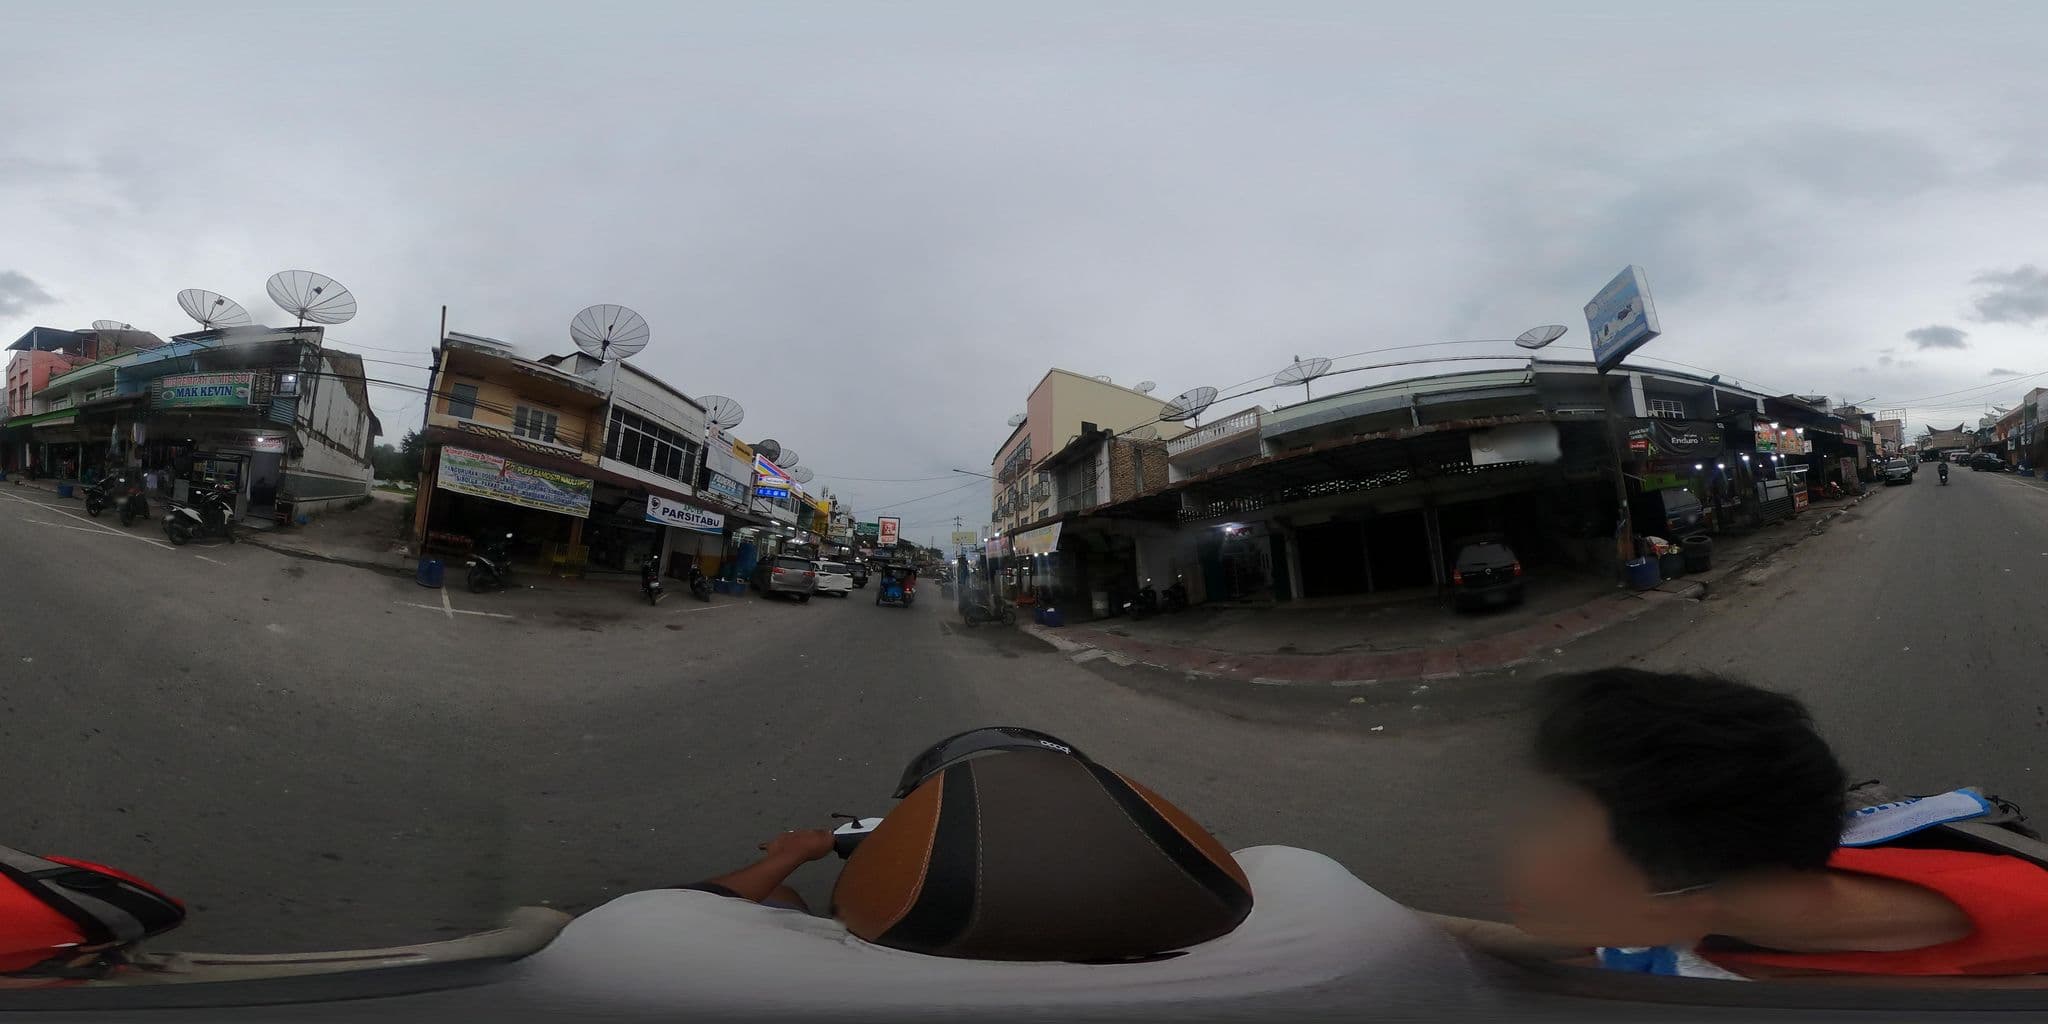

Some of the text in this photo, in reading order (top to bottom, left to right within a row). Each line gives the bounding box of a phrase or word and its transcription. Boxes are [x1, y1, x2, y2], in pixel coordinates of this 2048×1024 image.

[176, 386, 233, 398] MAK KEVIN
[1671, 436, 1699, 444] Enduro
[662, 507, 720, 527] PARSITABU
